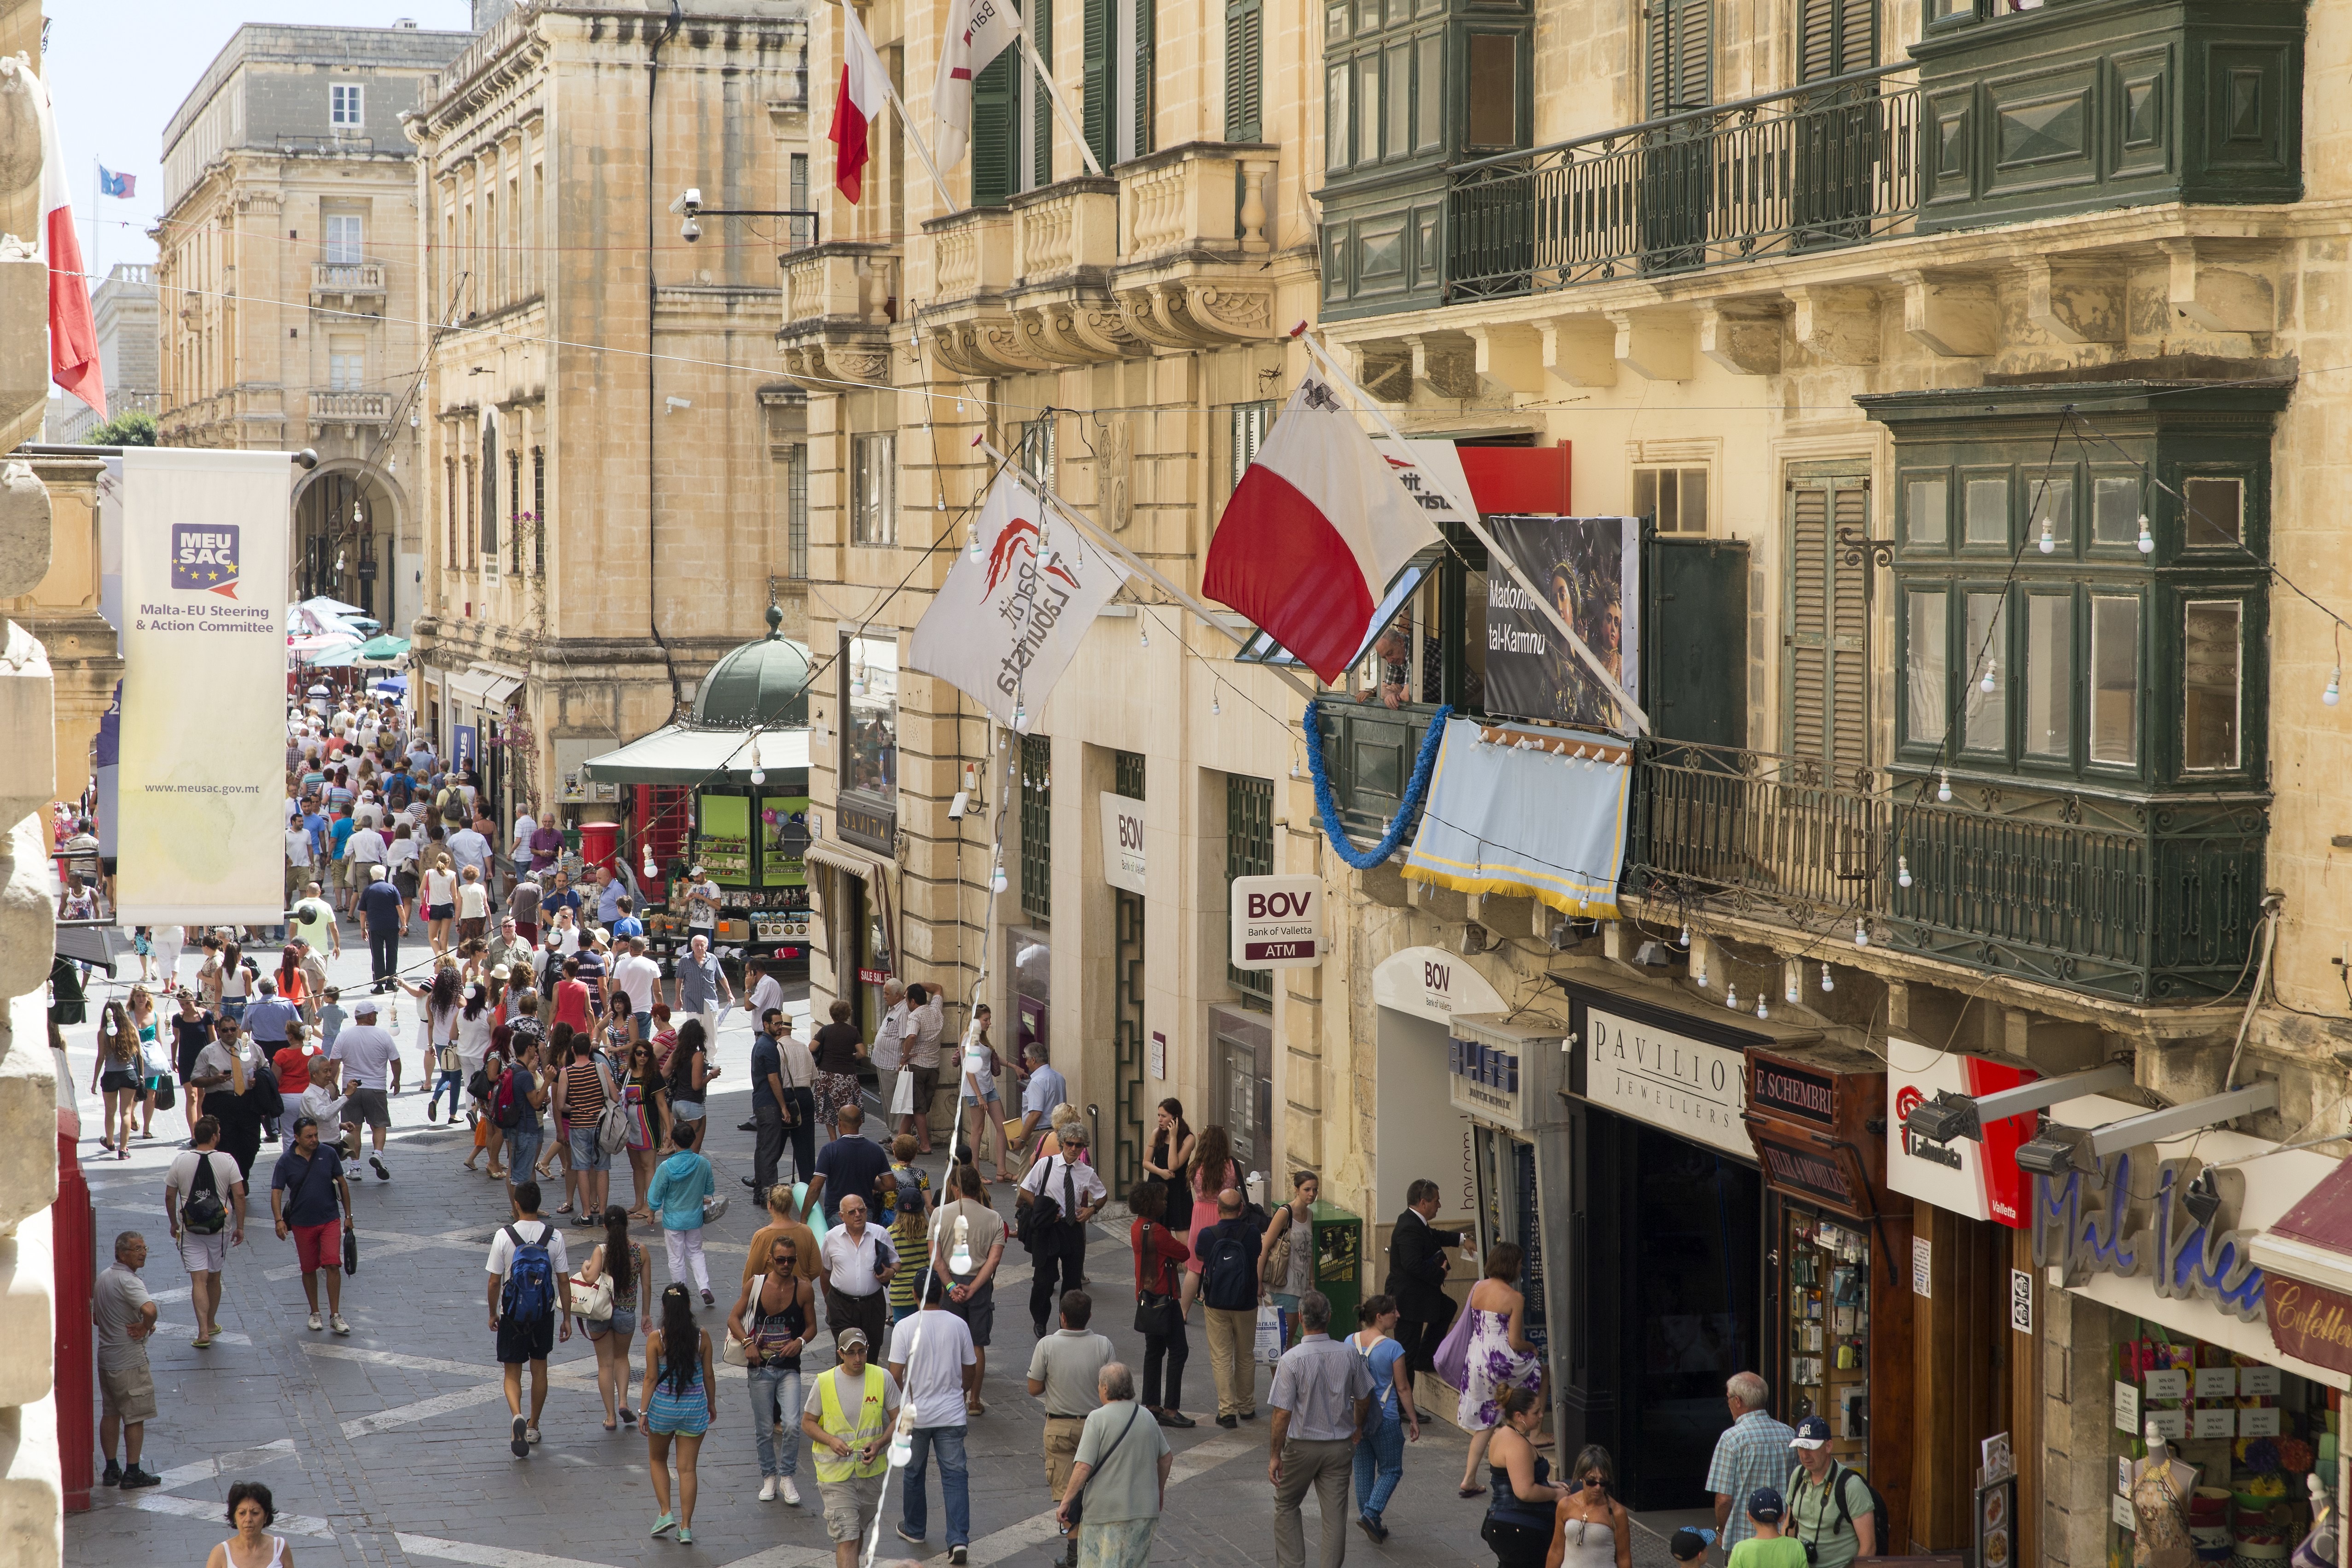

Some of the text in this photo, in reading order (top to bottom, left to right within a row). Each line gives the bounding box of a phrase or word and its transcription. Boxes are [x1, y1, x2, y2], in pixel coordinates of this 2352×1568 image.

[180, 534, 231, 548] MEU
[180, 548, 231, 565] SAC
[1490, 579, 1536, 611] Madonna
[141, 604, 269, 619] Malta-EU Steering
[137, 619, 274, 633] & Action Committee
[1489, 624, 1545, 654] tal-Karmnu
[109, 700, 119, 714] 2
[146, 783, 259, 794] www.meusac.gov.mt
[844, 810, 885, 839] SAVITA
[1119, 814, 1143, 851] BOV
[1122, 859, 1145, 876] Bank of Vallett
[1248, 892, 1311, 918] BOV
[1248, 926, 1312, 936] Bank of Valletta
[1265, 944, 1295, 957] ATM
[861, 971, 890, 983] SALE SALE
[1425, 961, 1450, 991] BOV
[1434, 999, 1438, 1008] of
[1438, 999, 1451, 1012] Valletta
[1449, 1036, 1518, 1093] BLISS
[1757, 1068, 1831, 1115] F. SCHEMBRI
[1616, 1077, 1729, 1128] JEWELLERS
[1911, 1135, 1962, 1170] Laburista
[1764, 1146, 1799, 1179] FELIX
[1799, 1157, 1847, 1196] MOBILES
[1992, 1199, 2016, 1218] Valletta
[1799, 1424, 1811, 1437] LA
